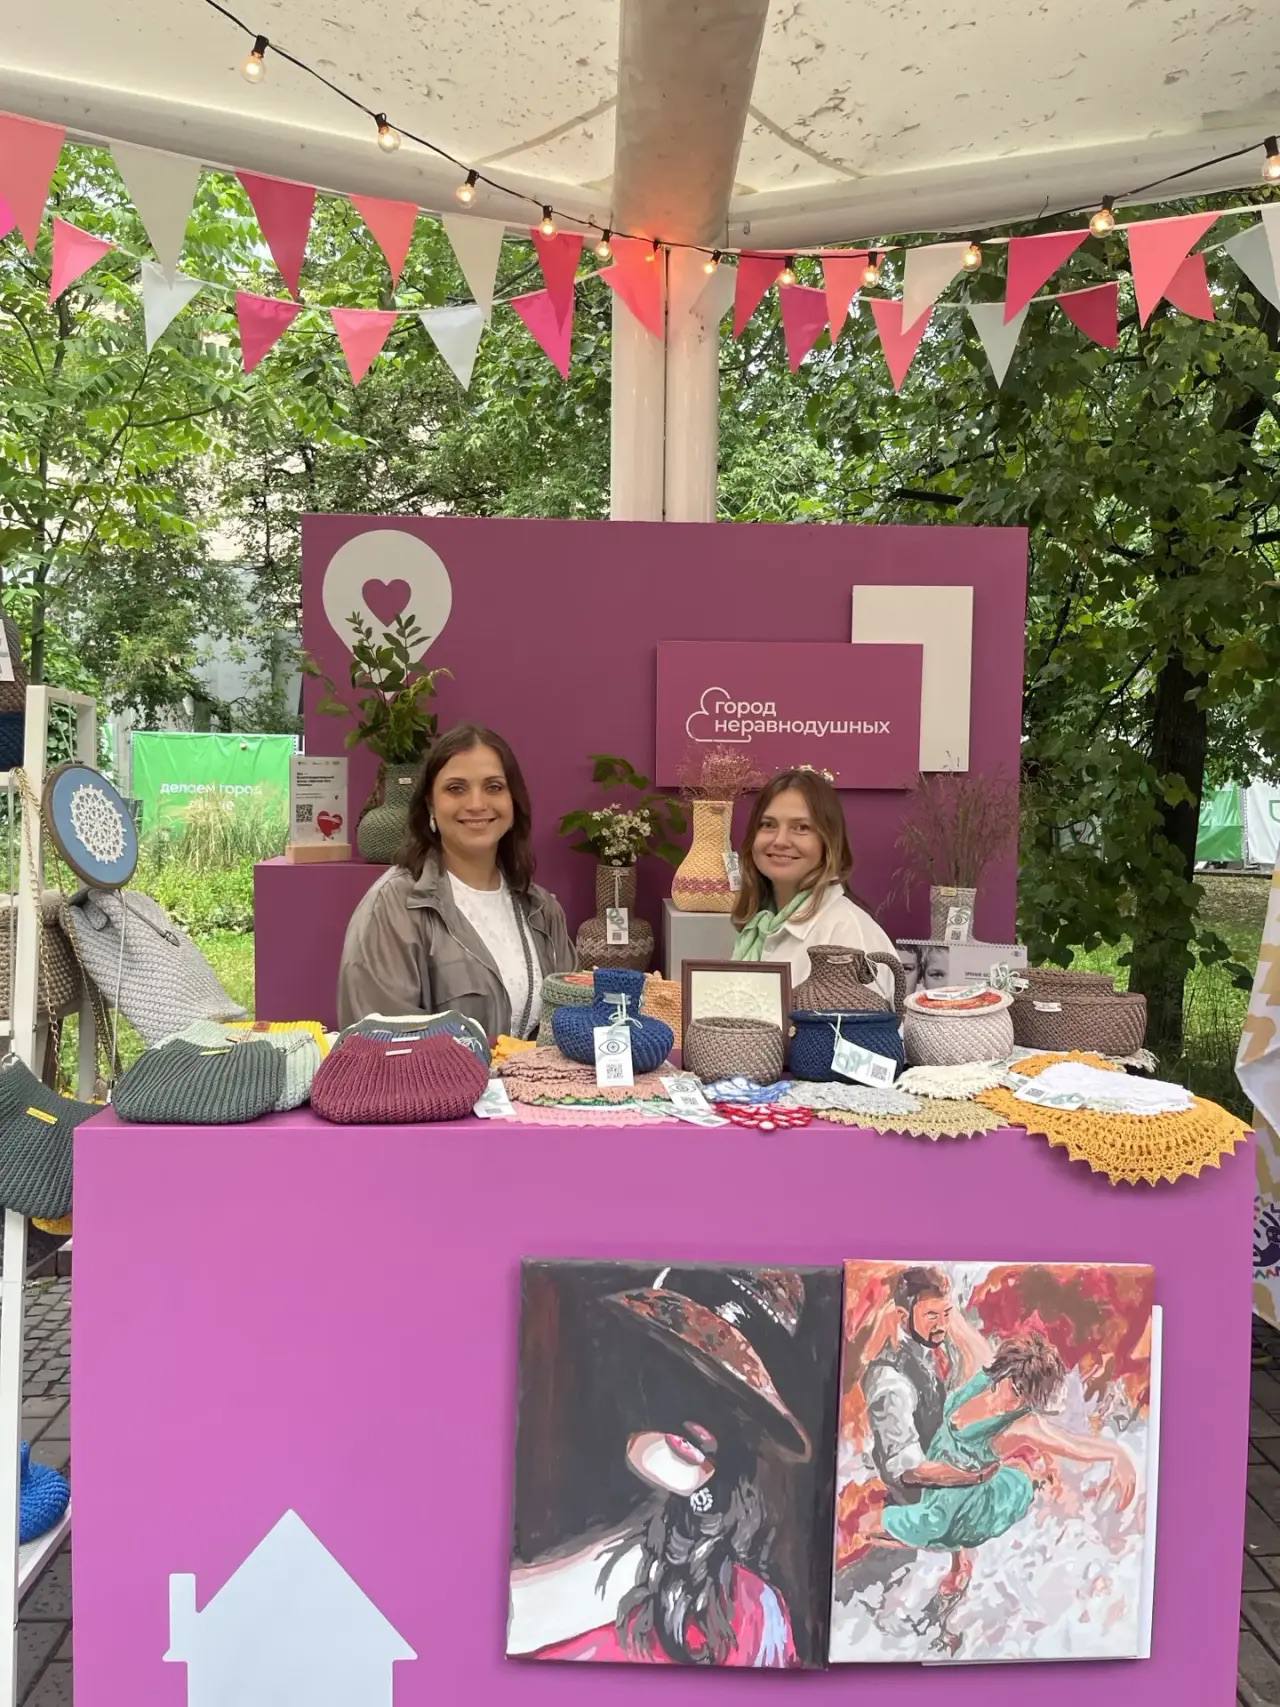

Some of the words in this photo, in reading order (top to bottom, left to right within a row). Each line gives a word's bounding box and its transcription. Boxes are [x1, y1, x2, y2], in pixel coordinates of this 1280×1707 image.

[715, 701, 776, 718] город
[714, 719, 891, 738] неравнодушных
[160, 783, 214, 795] делаем
